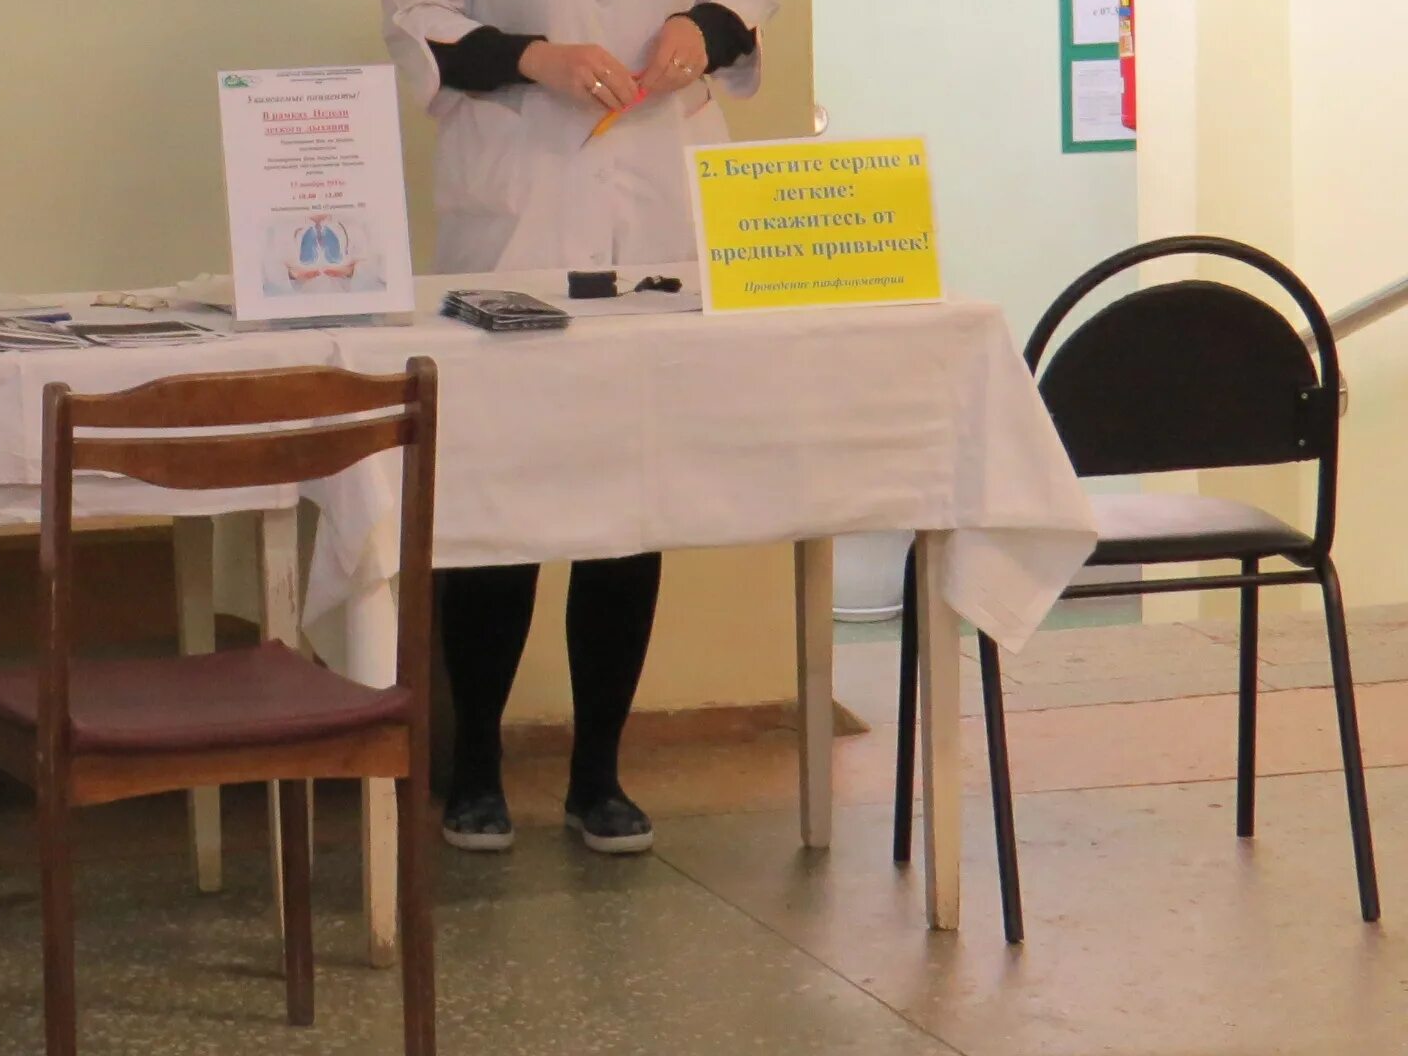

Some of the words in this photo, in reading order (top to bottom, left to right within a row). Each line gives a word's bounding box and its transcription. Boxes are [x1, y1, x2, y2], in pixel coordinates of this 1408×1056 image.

[700, 160, 717, 177] 2.
[725, 157, 823, 179] Берегите
[830, 154, 901, 174] сердце
[908, 154, 920, 166] и
[773, 184, 855, 202] легкие:
[739, 211, 866, 232] откажитесь
[873, 210, 896, 224] от
[711, 243, 804, 265] вредных
[812, 231, 929, 259] привычек!
[744, 280, 810, 293] Проведение
